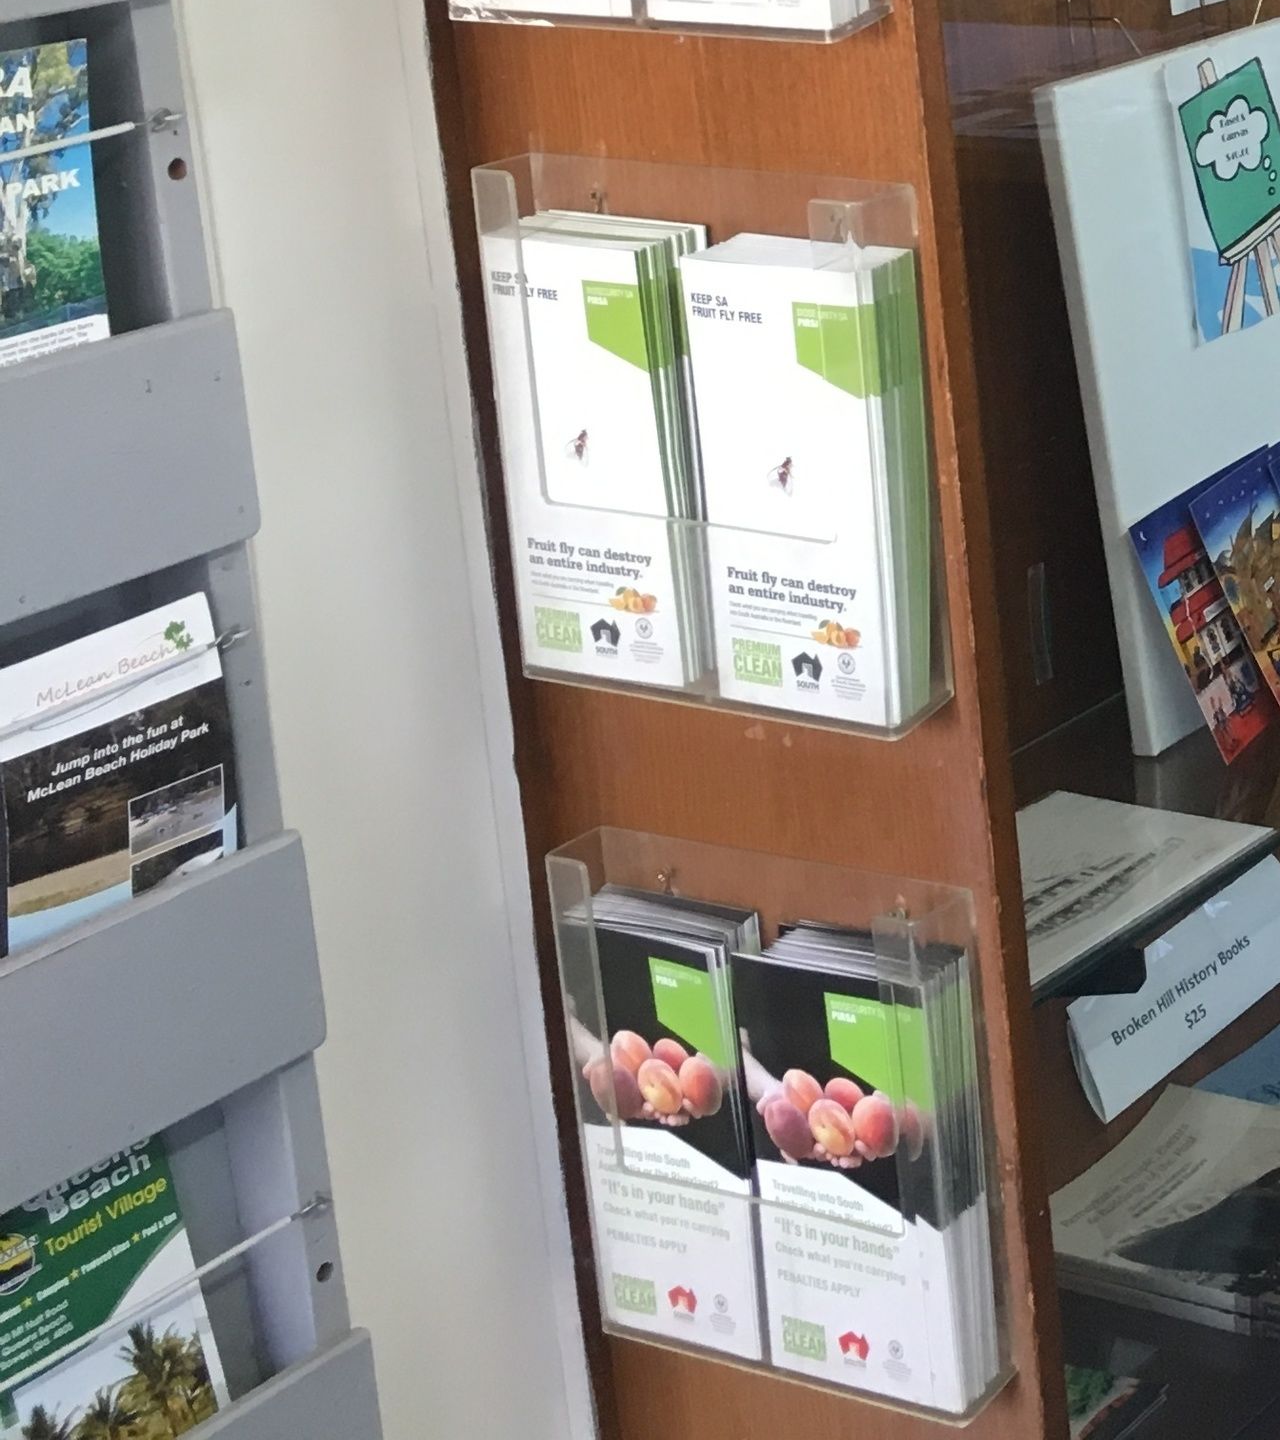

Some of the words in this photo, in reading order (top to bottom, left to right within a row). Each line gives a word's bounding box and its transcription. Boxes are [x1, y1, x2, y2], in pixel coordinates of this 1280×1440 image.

[491, 271, 512, 284] KEEP
[492, 282, 516, 297] FRUIT
[537, 287, 558, 301] FREE
[690, 291, 713, 306] KEEP
[715, 293, 728, 307] SA
[692, 305, 717, 319] FRUIT
[719, 307, 736, 321] FLY
[738, 310, 763, 324] FREE
[527, 537, 557, 553] Fruit
[559, 541, 575, 557] fly
[578, 546, 600, 558] can
[603, 548, 652, 567] destroy
[529, 554, 544, 565] an
[546, 556, 583, 571] entire
[586, 560, 644, 580] industry.
[727, 566, 758, 582] Fruit
[761, 571, 777, 587] fly
[780, 577, 805, 590] can
[807, 579, 857, 601] destroy
[728, 583, 744, 595] an
[747, 587, 786, 602] entire
[788, 591, 847, 614] industry.
[536, 624, 583, 646] CLEAN
[732, 637, 781, 657] PREMIUM
[35, 668, 113, 708] McLean
[117, 644, 175, 676] Beach
[733, 654, 783, 679] CLEAN
[796, 679, 820, 691] SOUTH
[51, 754, 90, 777] Jump
[93, 742, 119, 760] into
[123, 731, 144, 749] the
[147, 724, 168, 741] fun
[170, 714, 184, 730] at
[27, 776, 81, 803] McLean
[85, 756, 127, 781] Beach
[130, 737, 178, 764] Holiday
[180, 721, 209, 743] Park
[655, 974, 678, 988] PIRSA
[1111, 1007, 1157, 1046] Broken
[1156, 989, 1176, 1014] Hill
[1174, 960, 1219, 999] History
[1217, 935, 1251, 966] Books
[831, 1010, 857, 1024] PIRSA
[1184, 1003, 1208, 1030] $25
[47, 1153, 152, 1225] Beach
[631, 1184, 645, 1199] in
[647, 1188, 676, 1206] your
[43, 1211, 104, 1257] Tourist
[105, 1176, 168, 1220] Village
[805, 1224, 818, 1241] in
[820, 1227, 851, 1249] your
[807, 1249, 831, 1265] what
[777, 1268, 829, 1292] PENALTIES
[830, 1280, 861, 1299] APPLY
